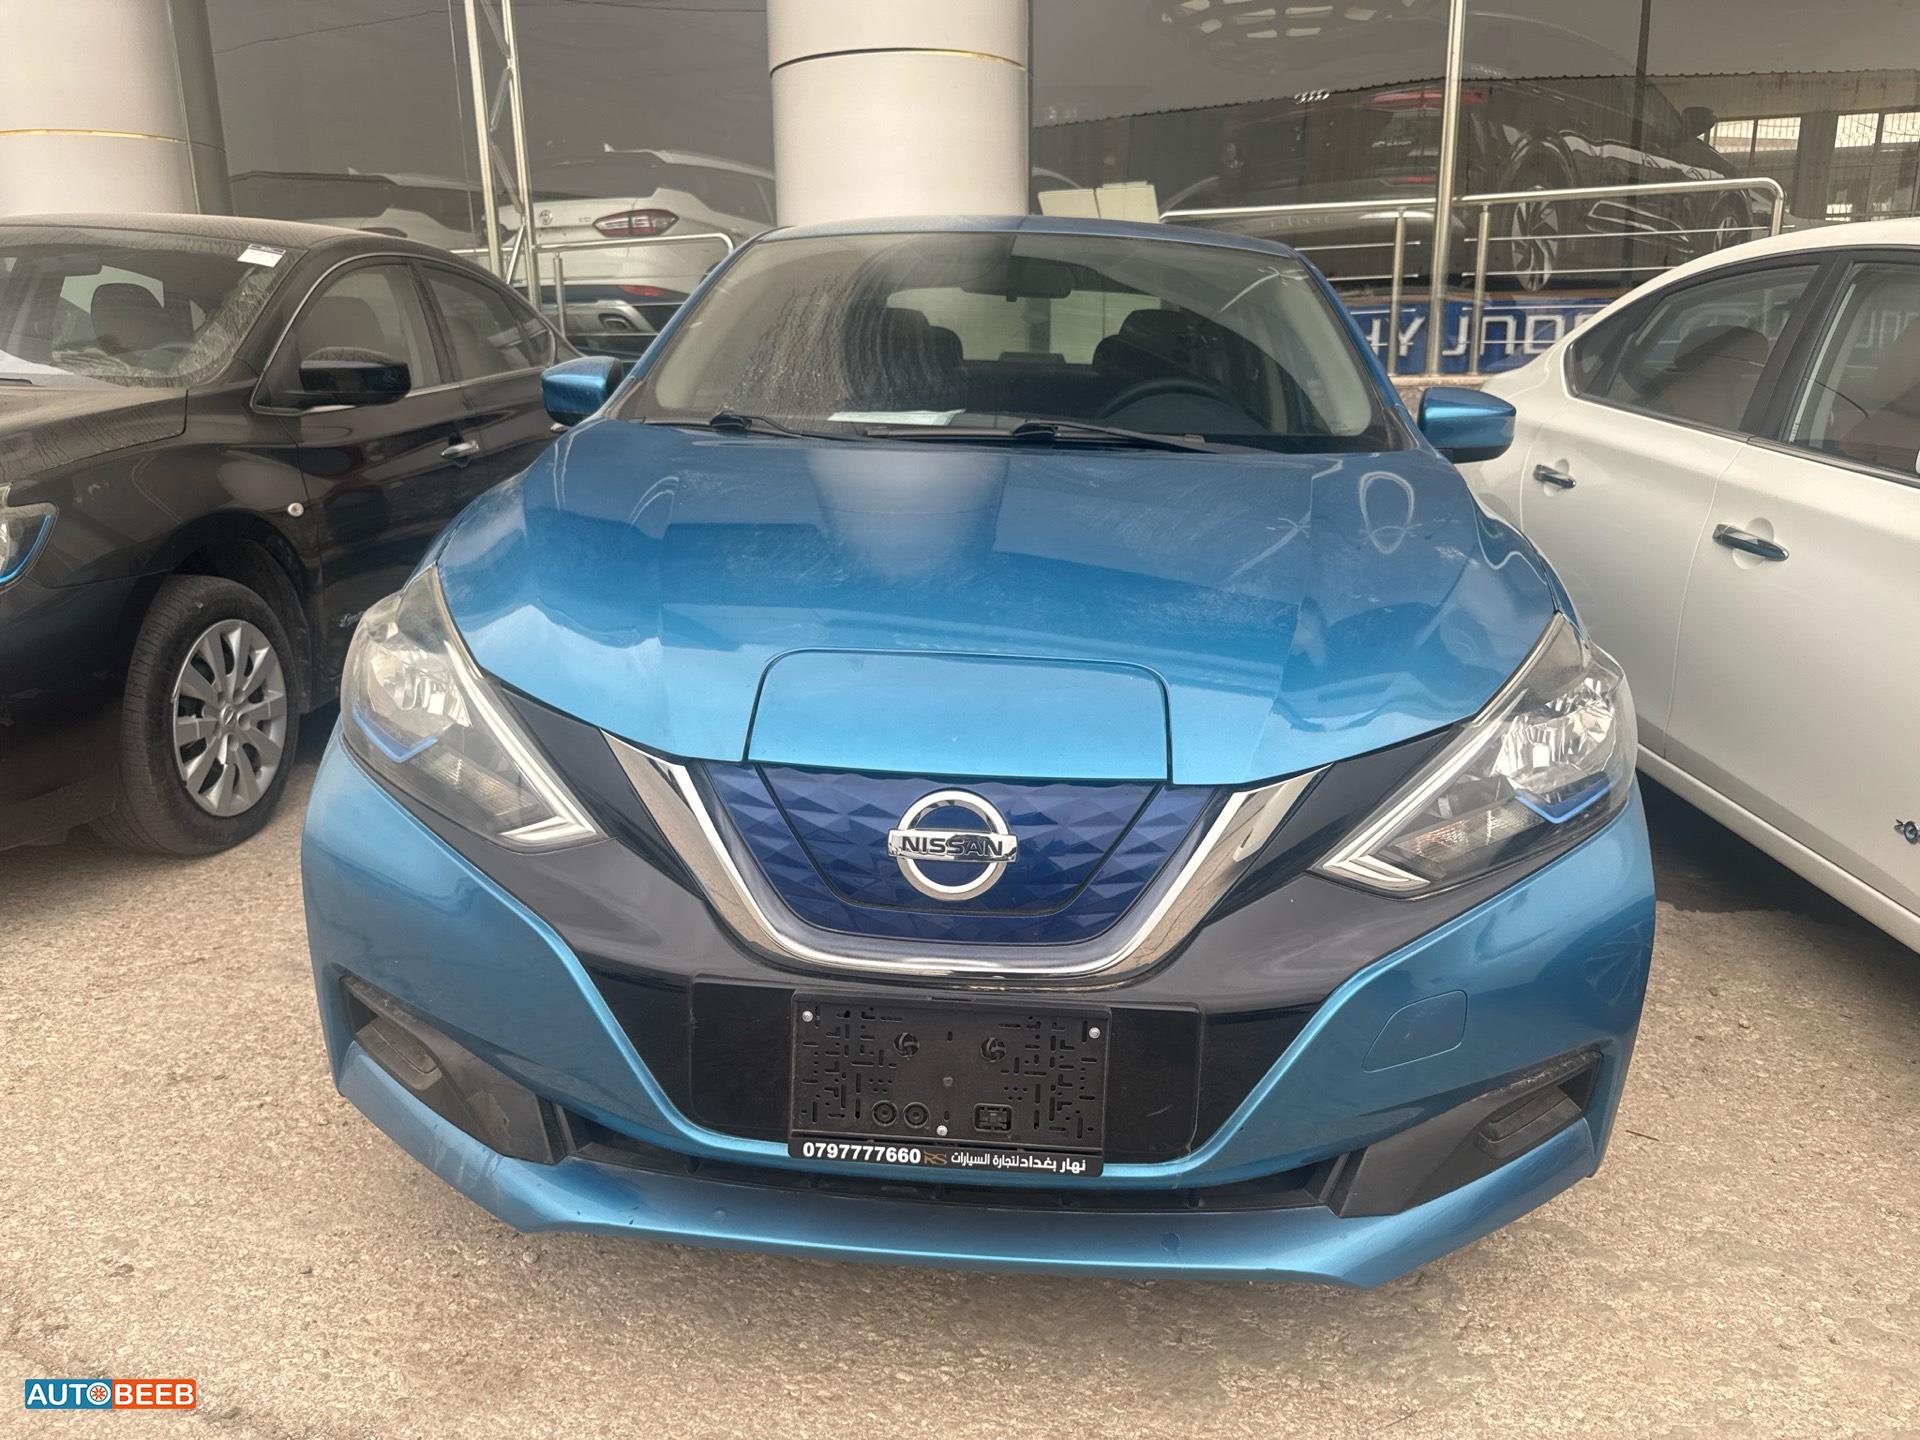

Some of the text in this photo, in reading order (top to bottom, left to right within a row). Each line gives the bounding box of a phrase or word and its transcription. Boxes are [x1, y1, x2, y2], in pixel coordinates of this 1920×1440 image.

[902, 836, 1003, 857] NISSAN
[802, 1142, 921, 1163] 0797777660
[951, 1151, 991, 1167] السيارات
[1060, 1158, 1086, 1174] نهار
